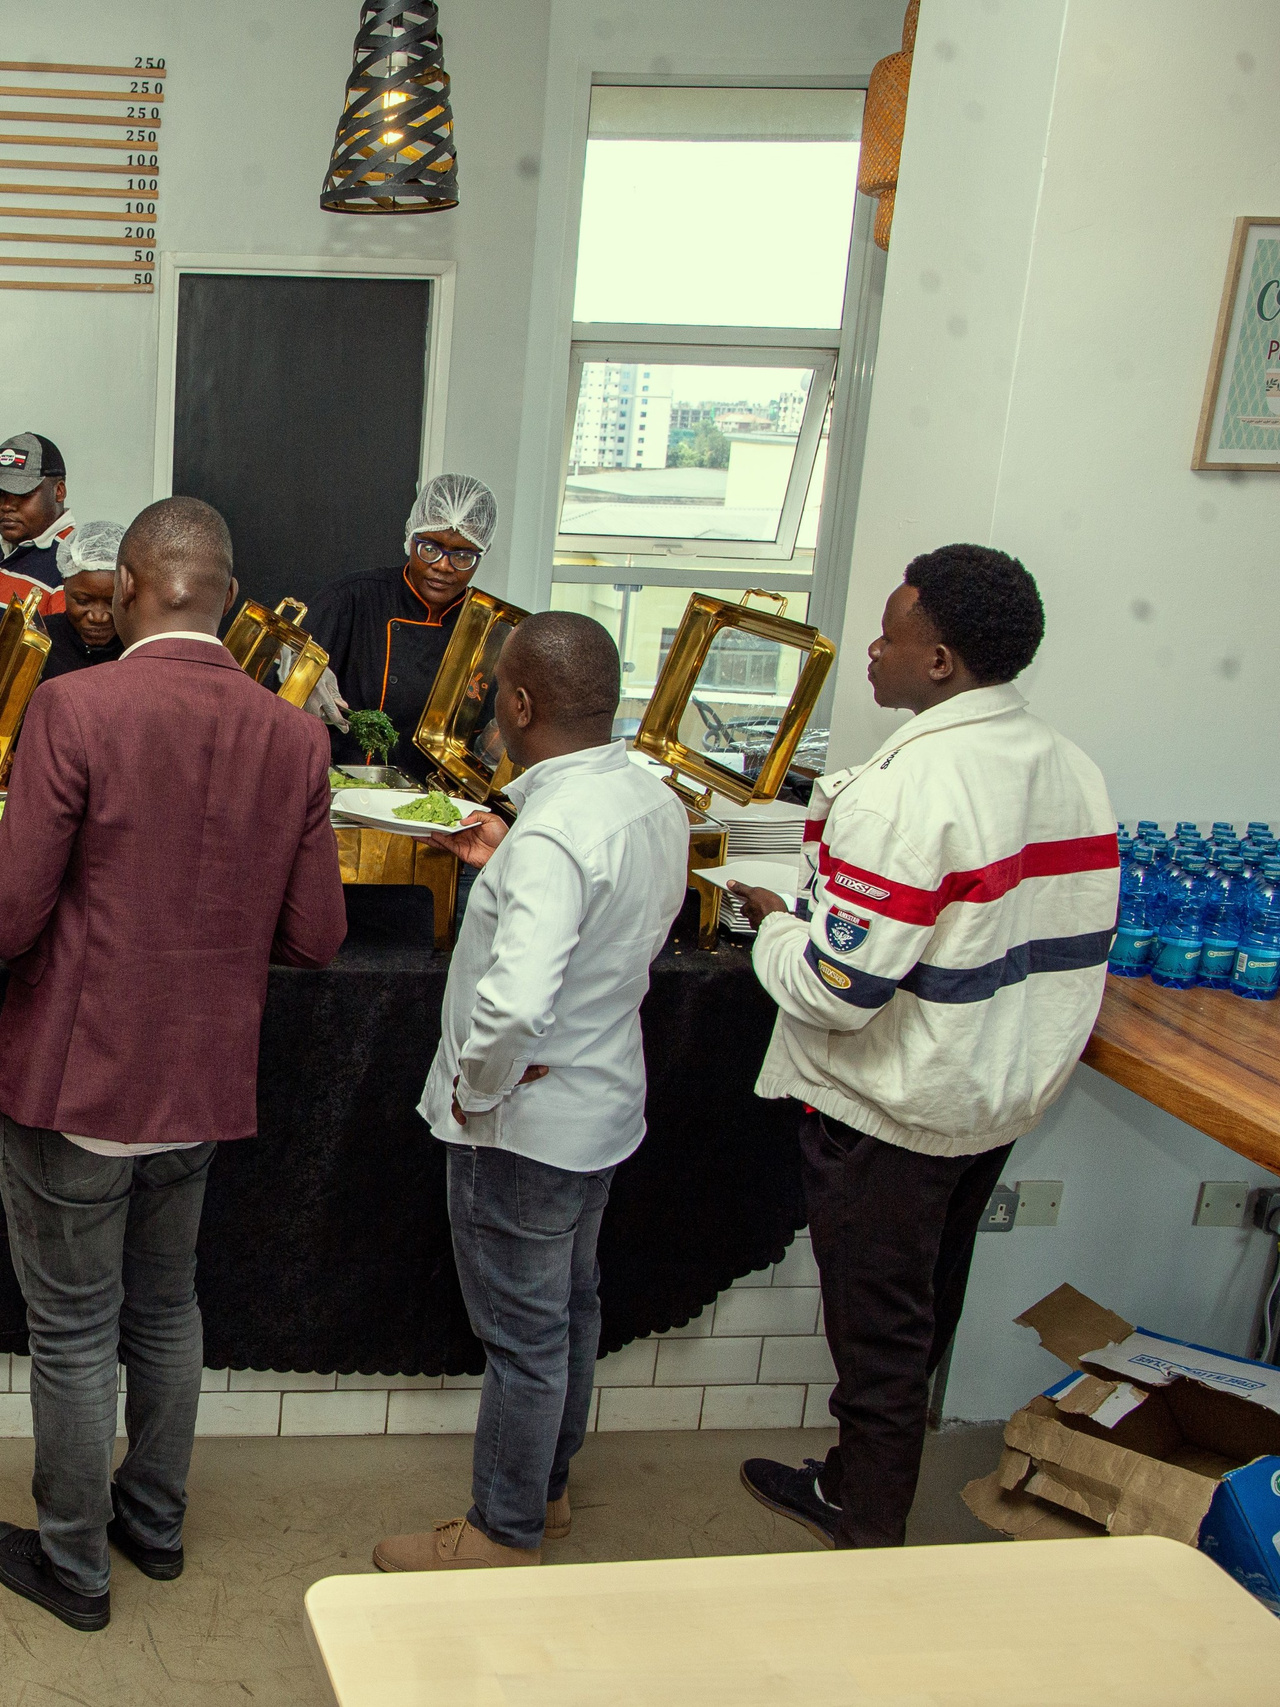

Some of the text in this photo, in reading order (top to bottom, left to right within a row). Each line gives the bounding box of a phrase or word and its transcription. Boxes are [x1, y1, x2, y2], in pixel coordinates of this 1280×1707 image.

[134, 57, 165, 70] 250
[130, 82, 162, 95] 250
[127, 107, 160, 120] 250
[126, 130, 157, 143] 250
[126, 155, 159, 167] 100
[127, 179, 157, 191] 100
[125, 203, 155, 214] 100
[125, 227, 154, 239] 200
[134, 250, 153, 262] 50
[134, 273, 153, 284] 50
[1267, 340, 1280, 360] P
